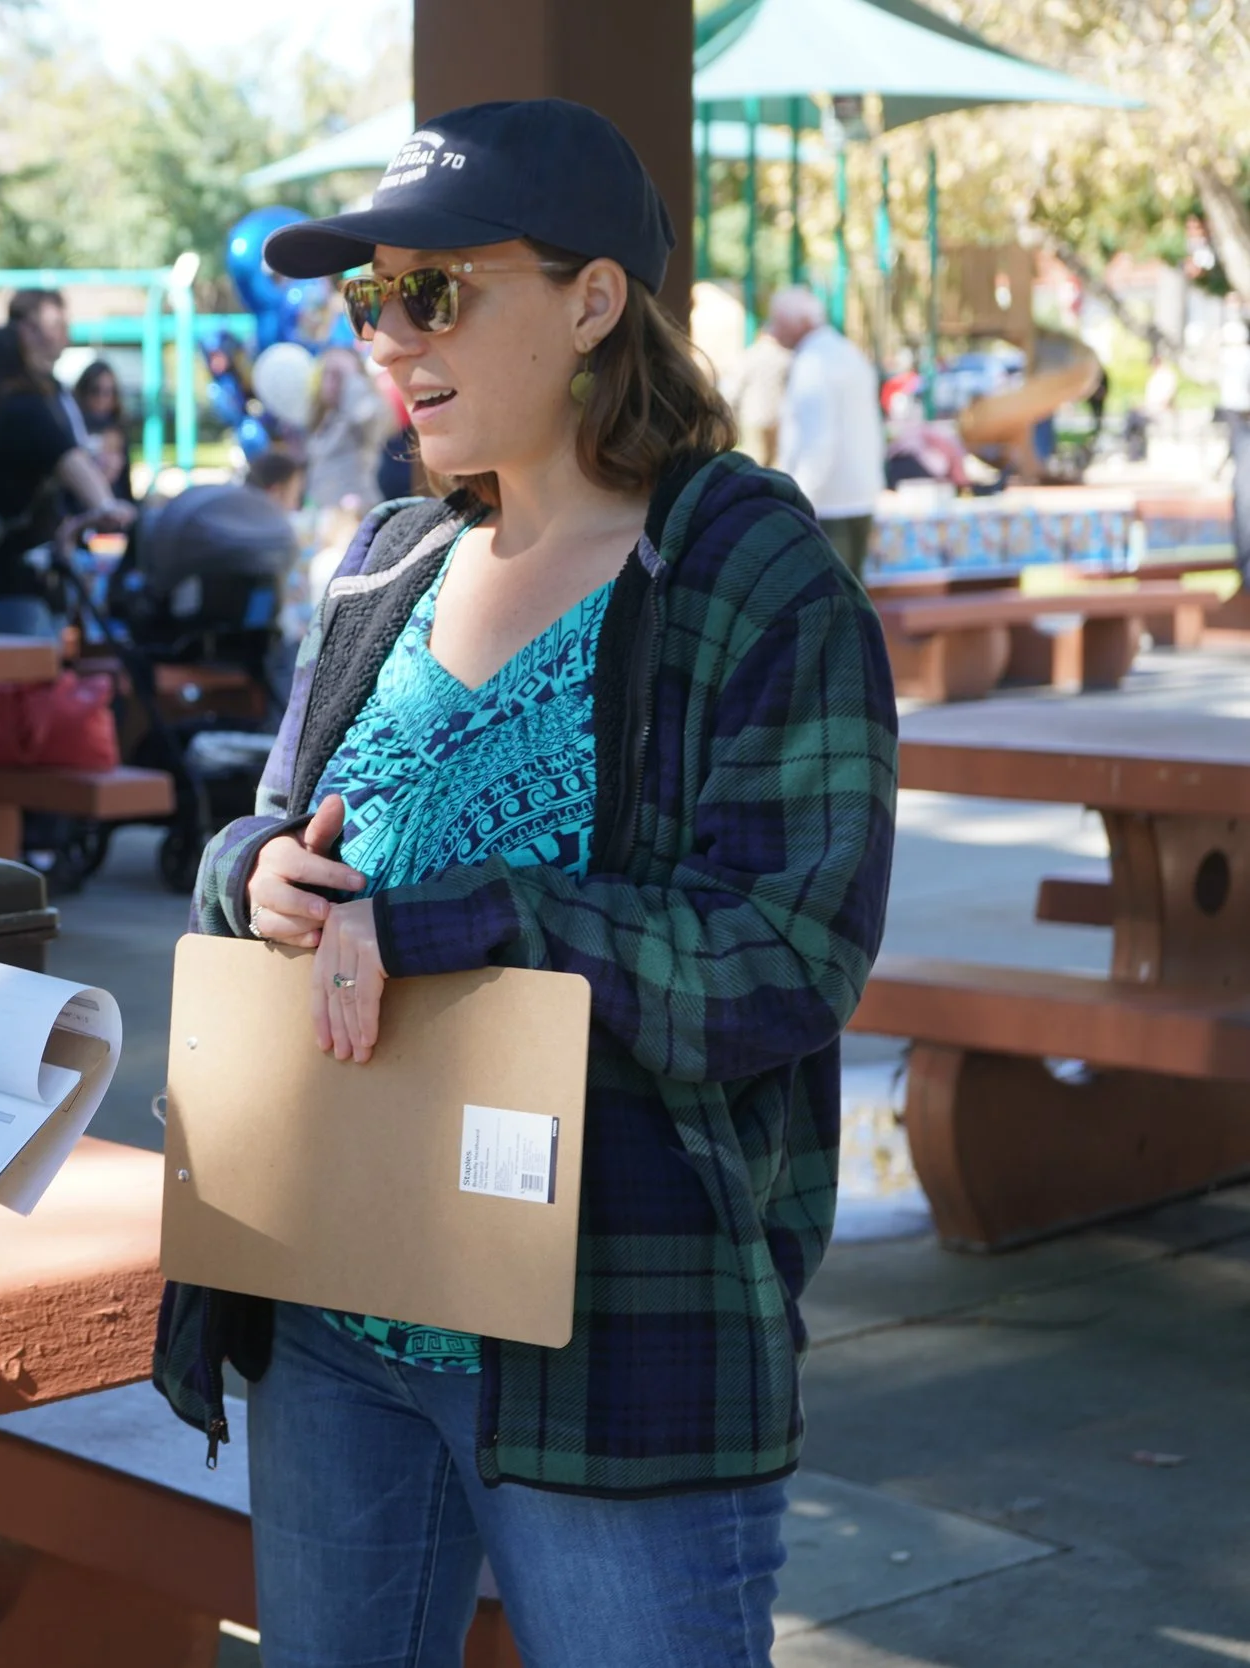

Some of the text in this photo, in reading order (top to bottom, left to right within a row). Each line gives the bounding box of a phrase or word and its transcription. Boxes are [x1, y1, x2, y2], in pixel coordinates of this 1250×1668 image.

[393, 149, 435, 169] LOCAL
[440, 152, 466, 170] 70
[463, 1150, 472, 1186] Staples
